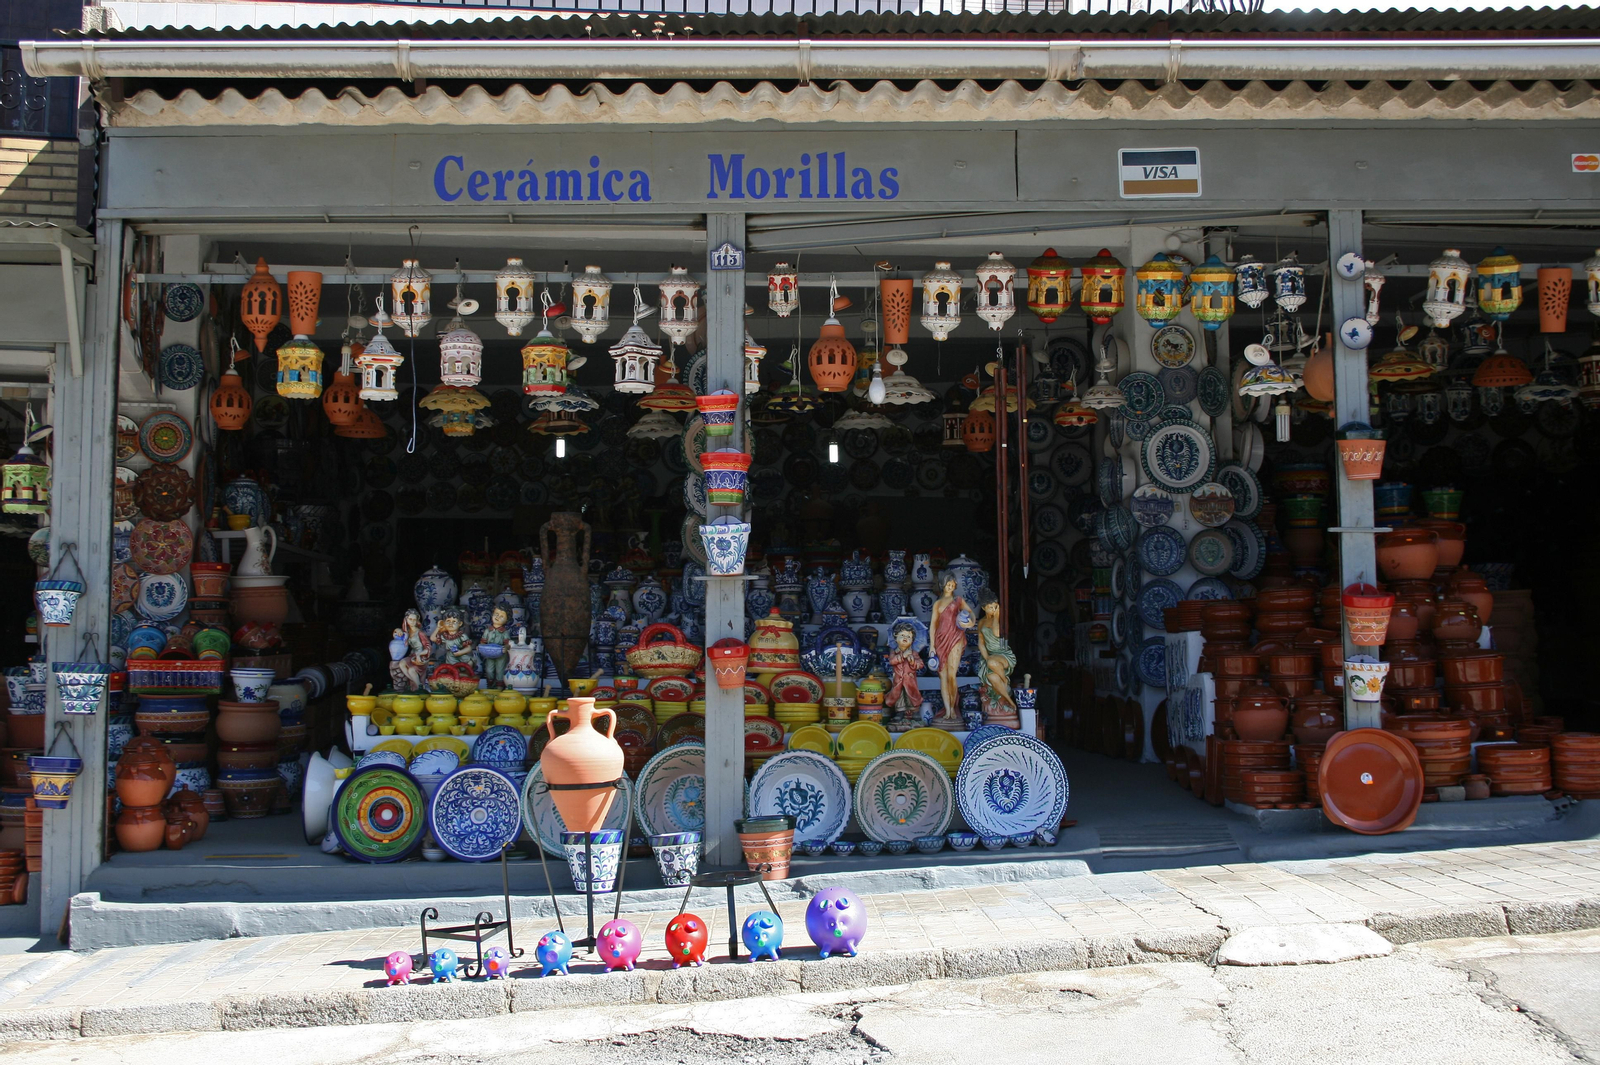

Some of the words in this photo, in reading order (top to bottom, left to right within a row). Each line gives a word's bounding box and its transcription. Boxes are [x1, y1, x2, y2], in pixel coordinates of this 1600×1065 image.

[434, 155, 651, 202] Cerámica
[707, 152, 899, 199] Morillas
[1142, 166, 1179, 179] VISA
[716, 254, 738, 266] 113
